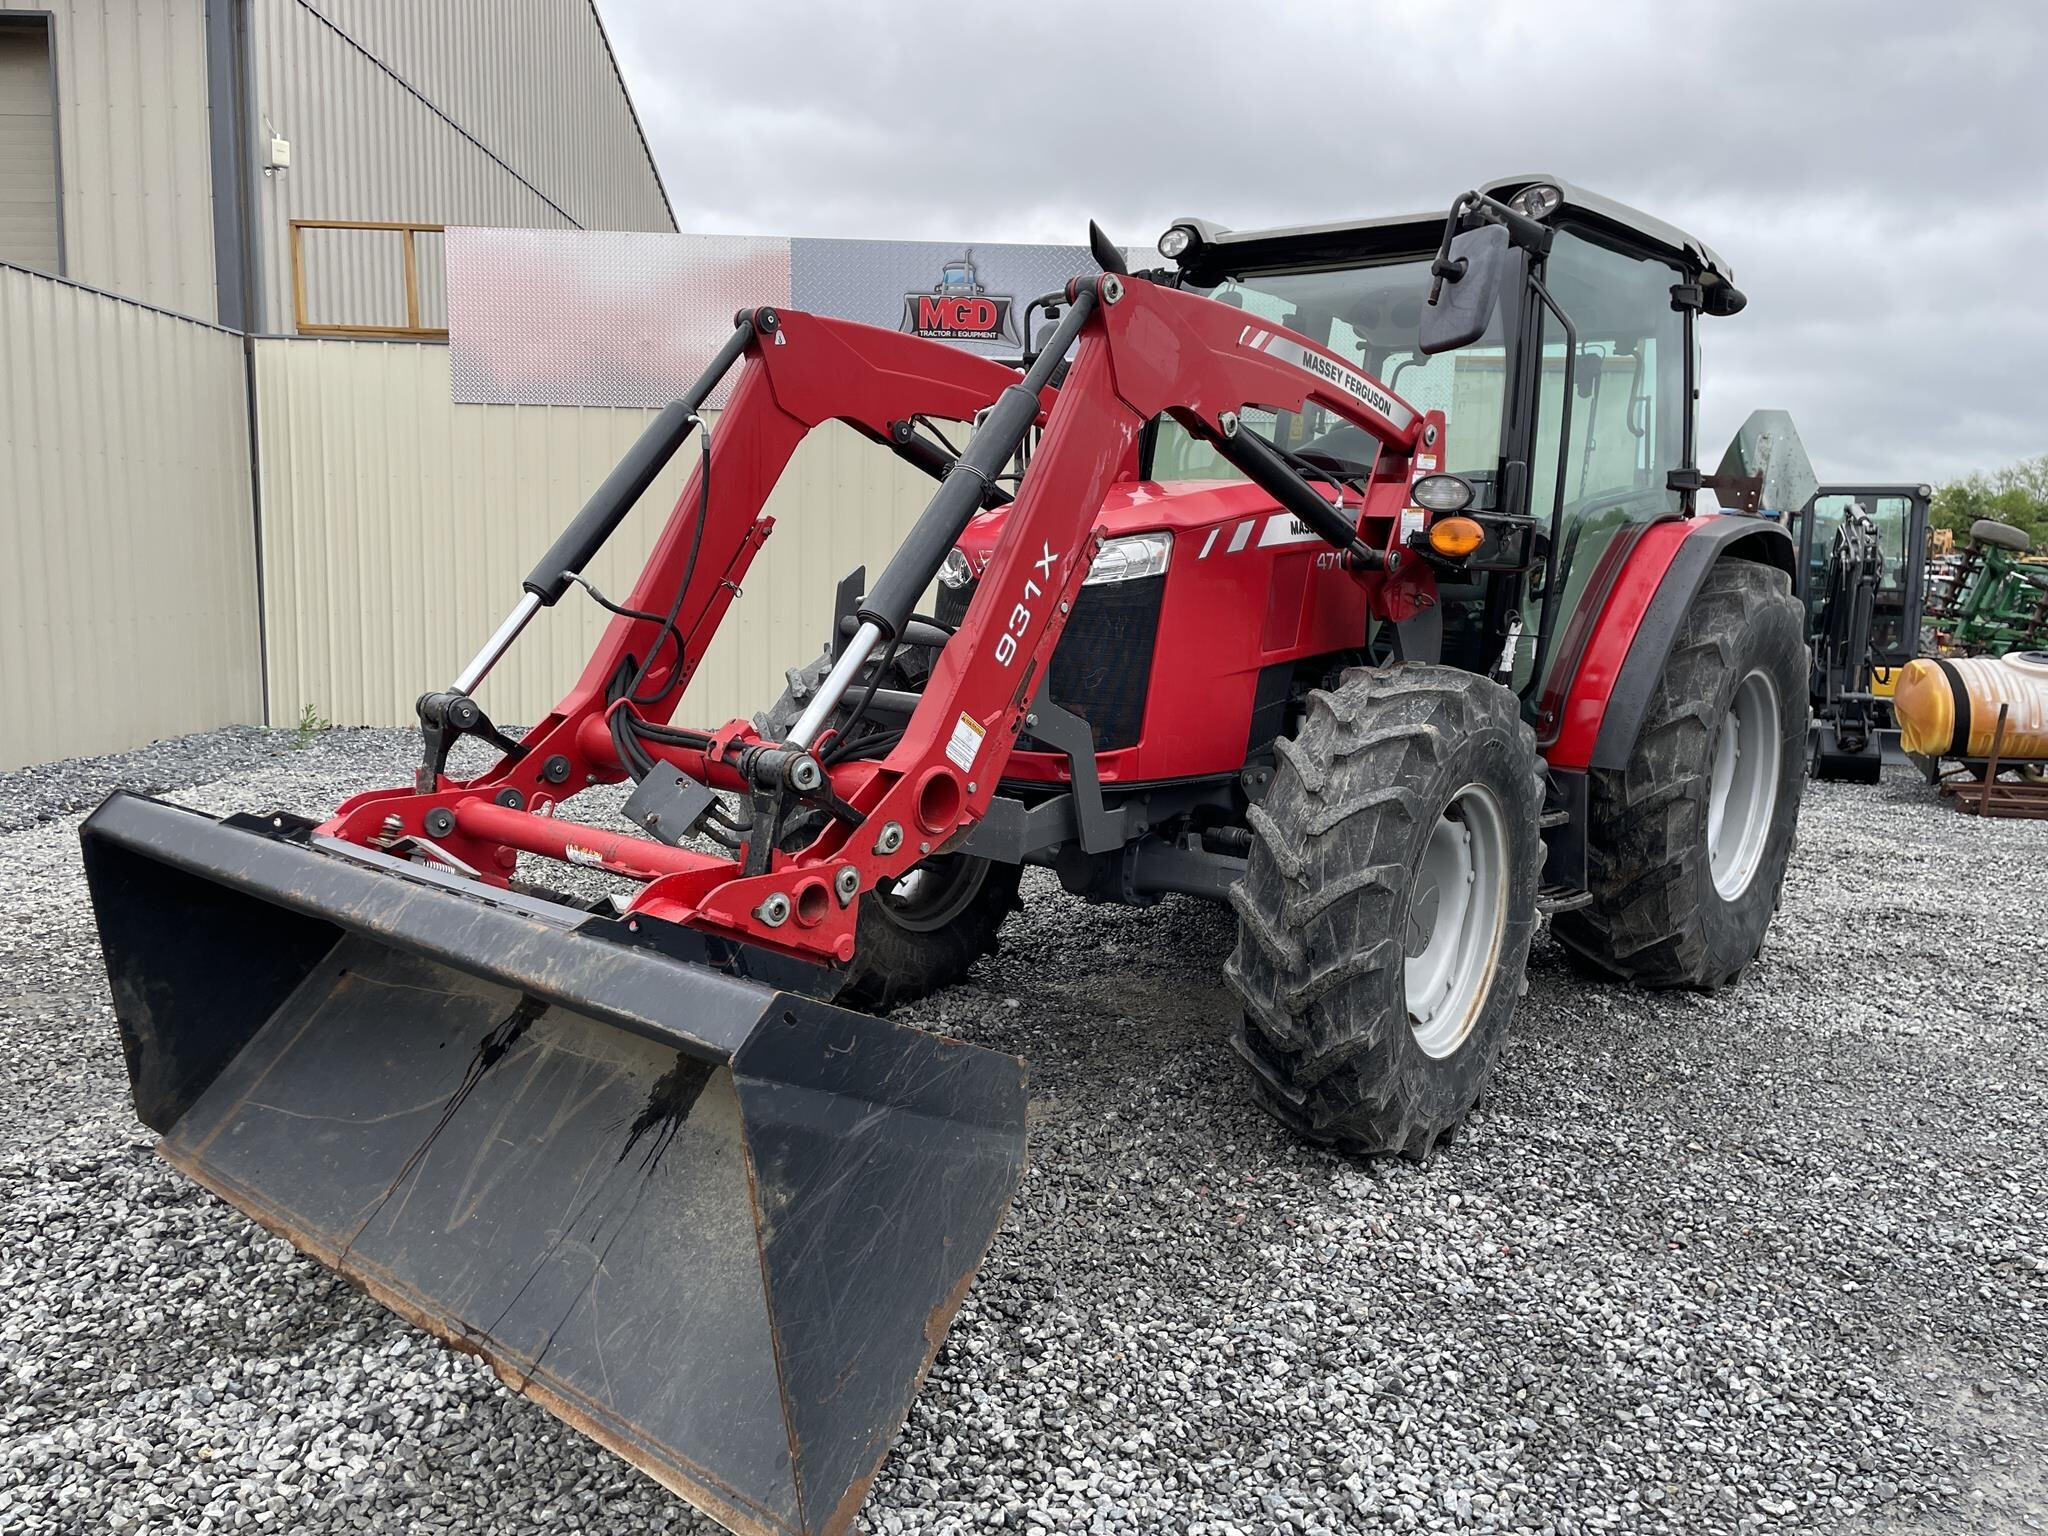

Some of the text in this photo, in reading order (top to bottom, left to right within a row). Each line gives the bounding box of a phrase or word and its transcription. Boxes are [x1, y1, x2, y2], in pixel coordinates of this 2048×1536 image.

[919, 296, 997, 330] MGD
[1303, 351, 1391, 416] MASSEY FERGUSON
